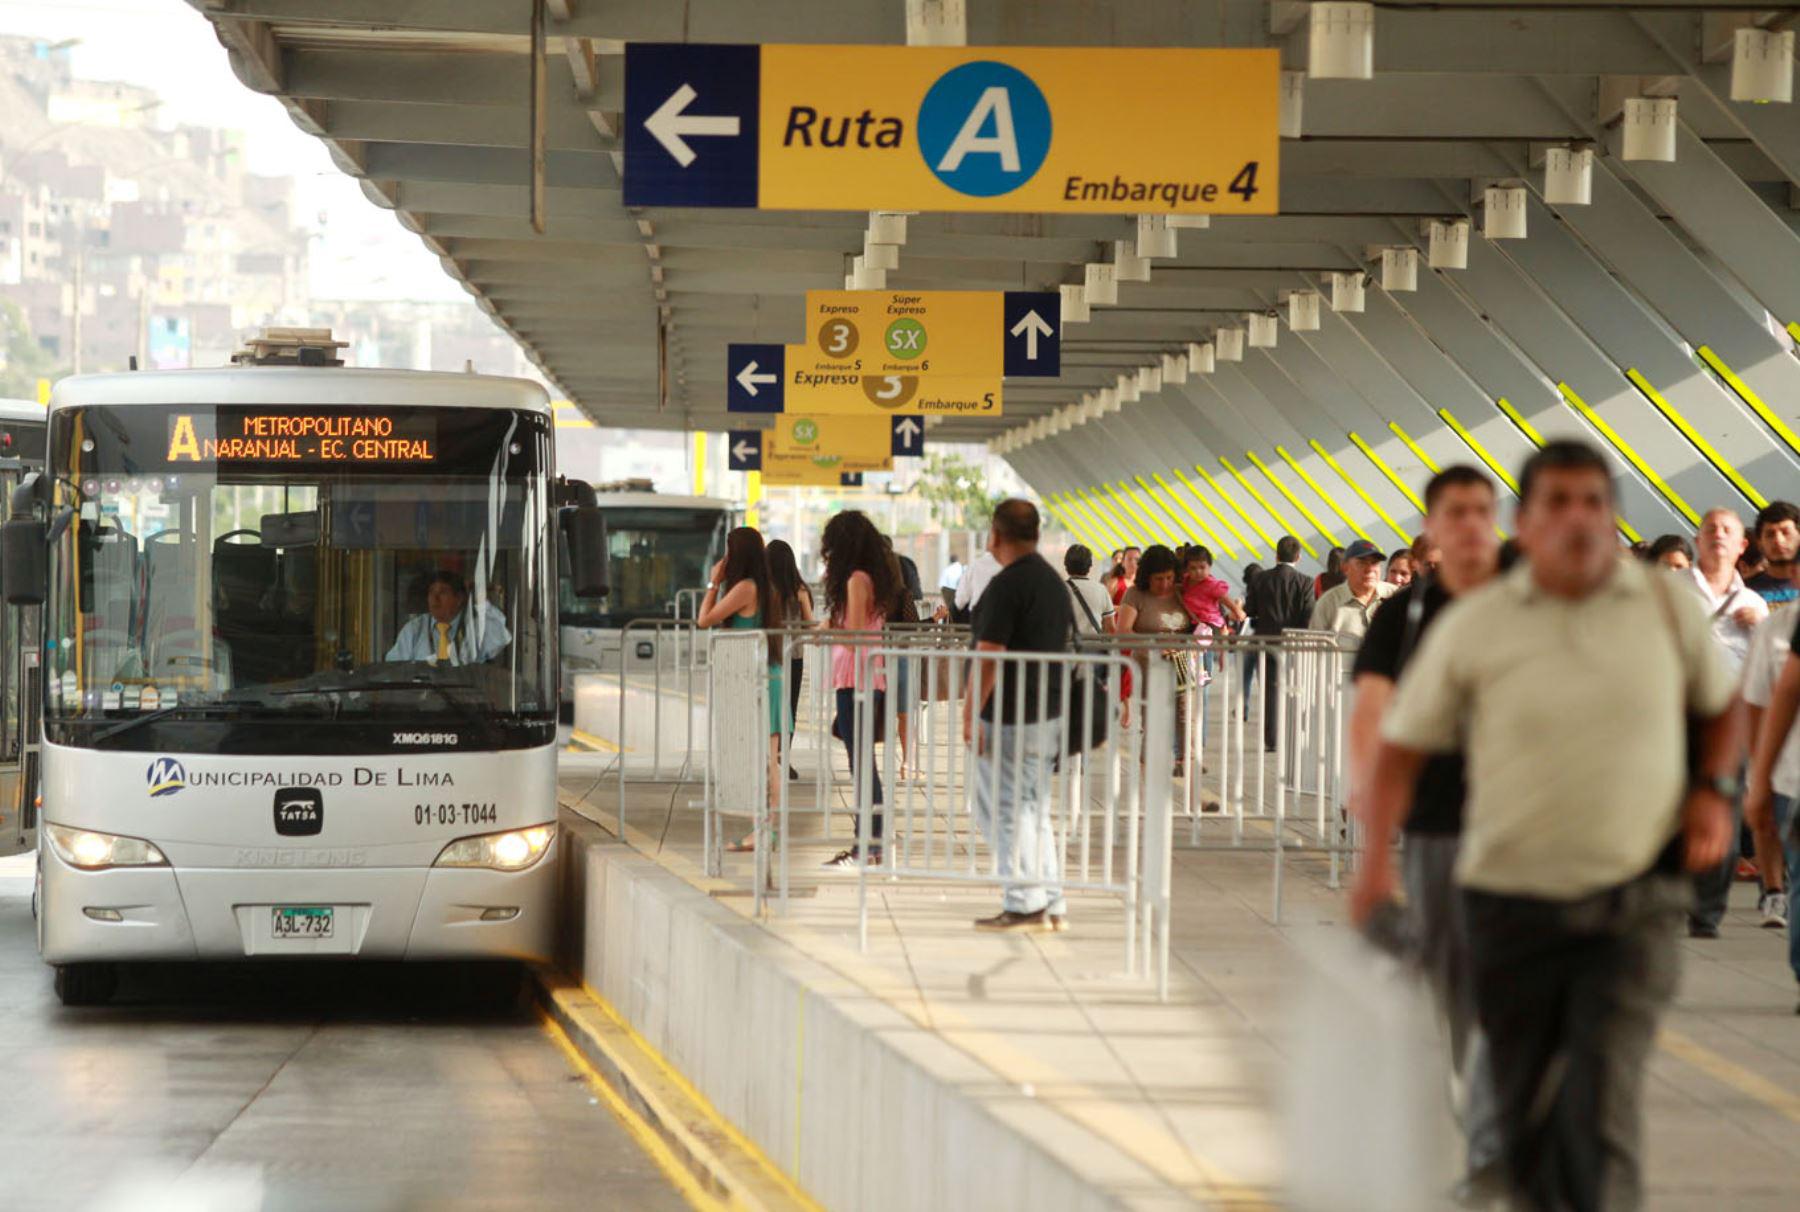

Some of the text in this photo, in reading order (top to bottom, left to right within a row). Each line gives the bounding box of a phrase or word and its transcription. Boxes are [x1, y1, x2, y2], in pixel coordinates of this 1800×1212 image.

[783, 87, 1021, 172] Ruta A
[1063, 161, 1259, 206] Embarque 4
[892, 295, 922, 305] Super
[819, 304, 860, 315] Expreso
[887, 305, 926, 316] Expreso
[828, 324, 850, 353] 3
[889, 329, 921, 350] SX
[815, 360, 862, 371] Embarque 5
[921, 360, 929, 371] 6
[794, 371, 860, 387] Expreso
[917, 393, 995, 411] Embarque 5
[243, 417, 393, 436] METROPOLITANO
[794, 424, 815, 439] SX
[167, 416, 202, 461] A
[203, 439, 302, 459] NARANJAL
[320, 439, 347, 459] EC.
[352, 440, 434, 459] CENTRAL
[280, 811, 317, 821] TATSA
[414, 803, 497, 825] 01-03-T044
[275, 914, 331, 933] A3L-732
